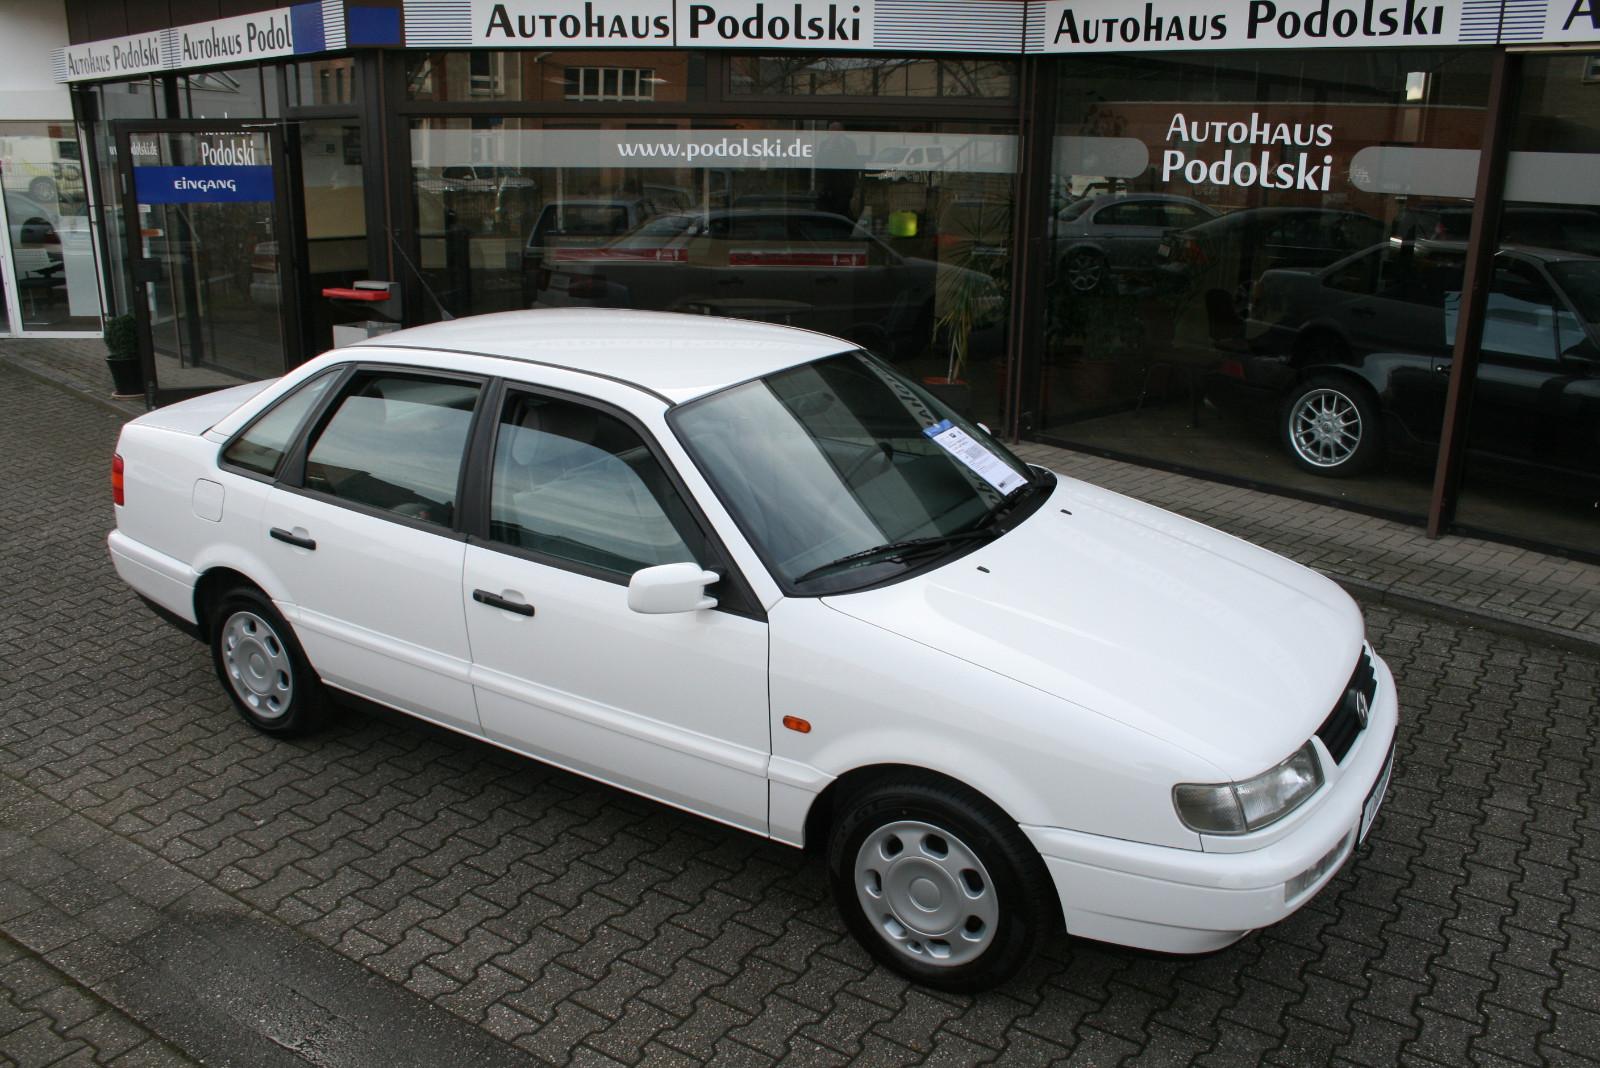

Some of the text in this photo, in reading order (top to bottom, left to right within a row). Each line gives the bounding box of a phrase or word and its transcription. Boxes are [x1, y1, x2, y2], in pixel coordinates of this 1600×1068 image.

[689, 2, 861, 41] Podolski
[1246, 0, 1445, 40] Podolski
[112, 36, 160, 71] Podolski
[201, 139, 257, 166] Podolski
[1161, 149, 1334, 192] Podolski
